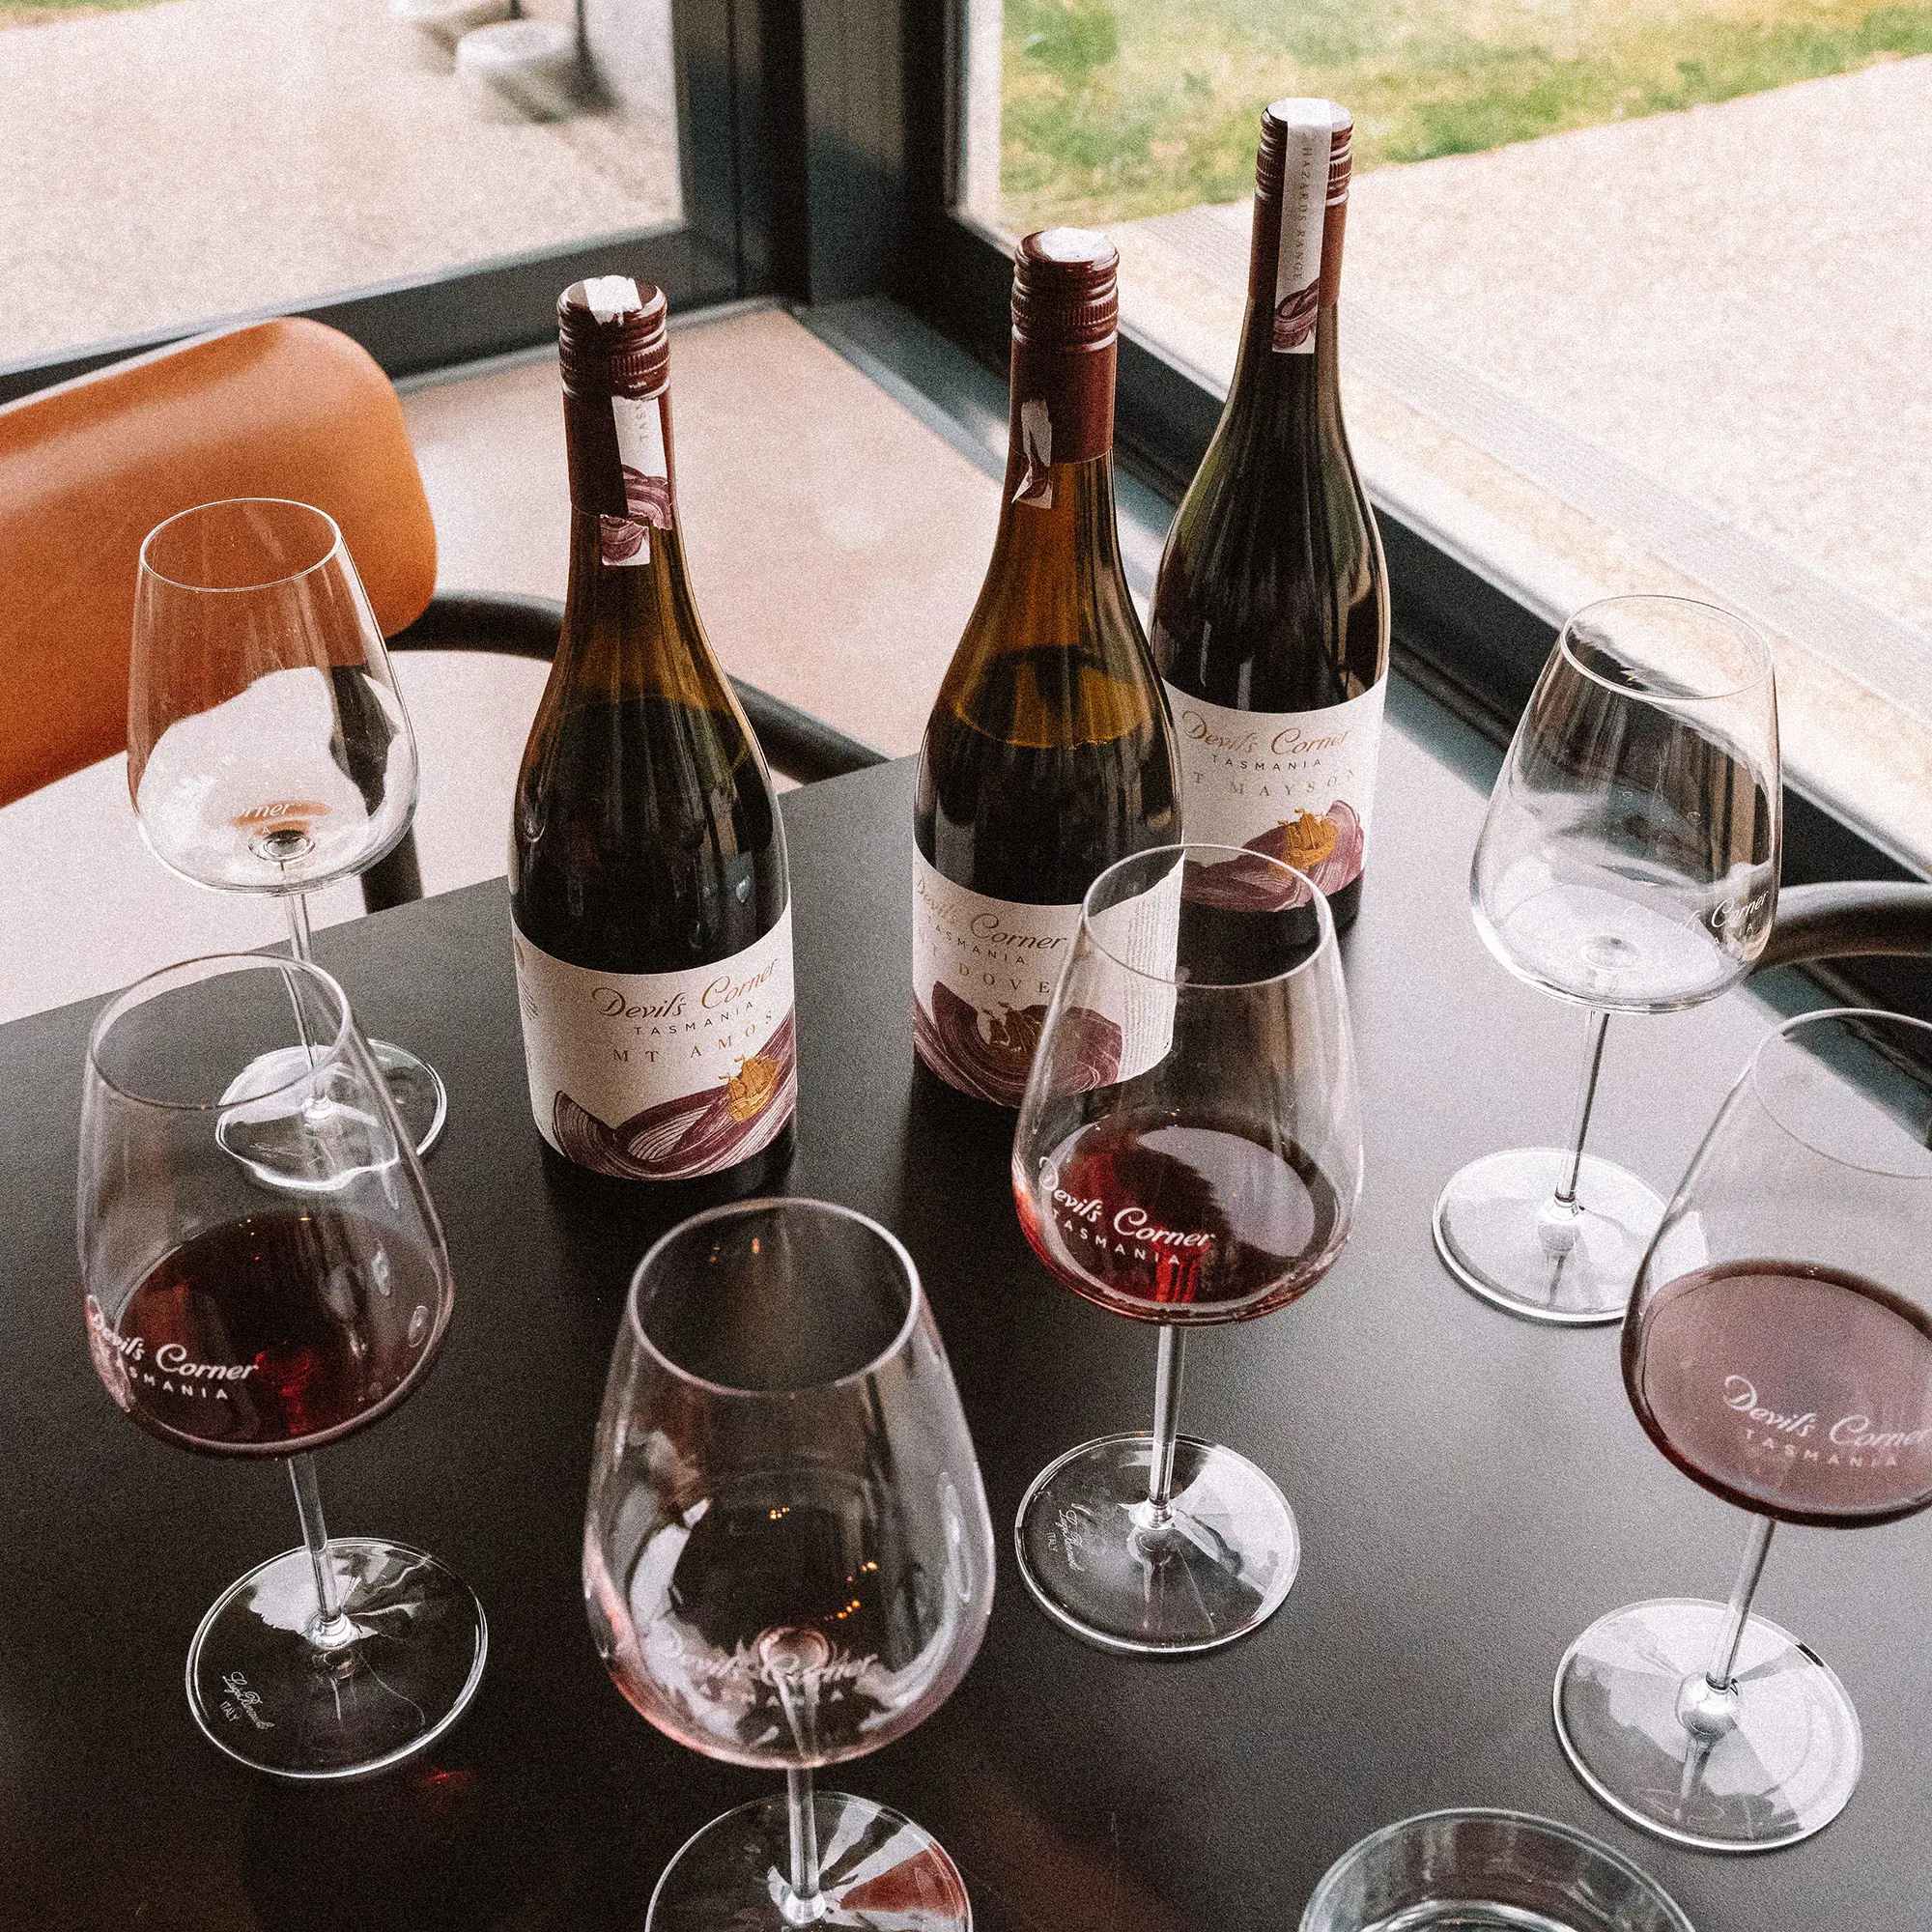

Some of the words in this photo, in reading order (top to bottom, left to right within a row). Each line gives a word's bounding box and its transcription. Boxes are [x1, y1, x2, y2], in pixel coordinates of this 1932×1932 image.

[1271, 727, 1352, 755] Corner
[1211, 754, 1321, 770] TASMANIA
[1711, 889, 1770, 928] Corner
[927, 914, 1026, 965] TASMANIA
[971, 913, 1067, 951] Corner
[591, 986, 688, 1020] Devil's
[701, 957, 778, 1010] Corner
[959, 962, 1051, 994] DOVE
[612, 1049, 662, 1064] MT
[689, 1010, 773, 1059] AMOS
[634, 1001, 753, 1037] TASMANIA
[1053, 1208, 1180, 1265] TASMANIA
[1113, 1207, 1216, 1247] Corner
[155, 1343, 260, 1380] Corner
[128, 1365, 229, 1400] SMANIA
[1745, 1427, 1898, 1468] TASMANIA
